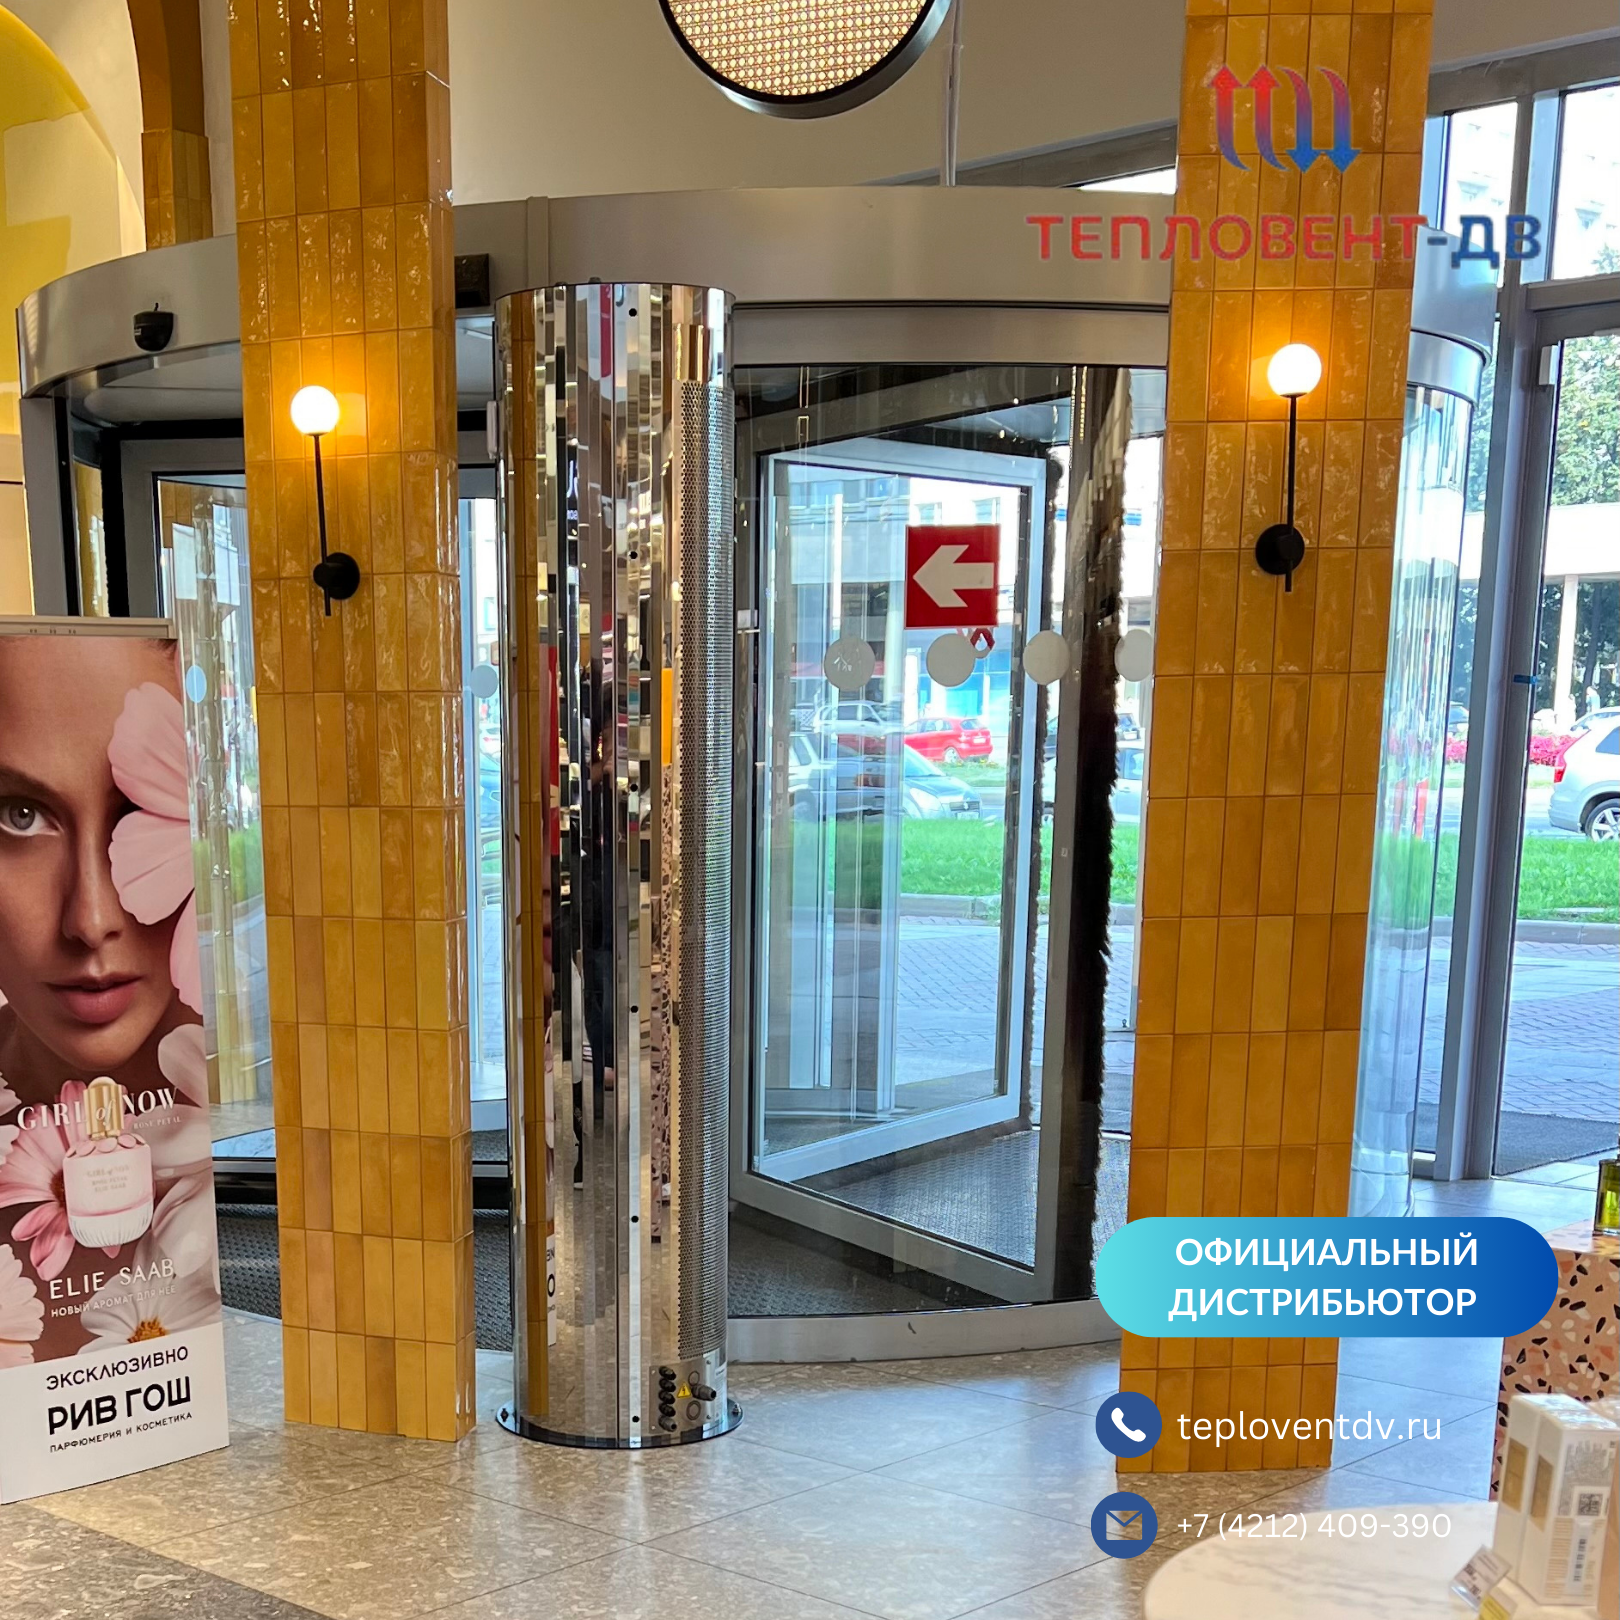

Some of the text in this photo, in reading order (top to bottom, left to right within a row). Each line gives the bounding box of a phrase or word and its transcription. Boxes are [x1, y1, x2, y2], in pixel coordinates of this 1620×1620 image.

[17, 1088, 175, 1131] GIRL of NOW
[156, 1115, 182, 1127] PETAL
[49, 1258, 174, 1300] ELIE SAAB
[51, 1301, 90, 1318] НОВЫЙ
[93, 1293, 134, 1310] АРОМАТ
[136, 1289, 156, 1302] ДЛЯ
[46, 1346, 189, 1390] ЭКСКЛЮЗИВНО
[47, 1376, 191, 1436] РИВ ГОШ
[50, 1412, 193, 1453] ПАРФЮМЕРИЯ И КОСМЕТИКА
